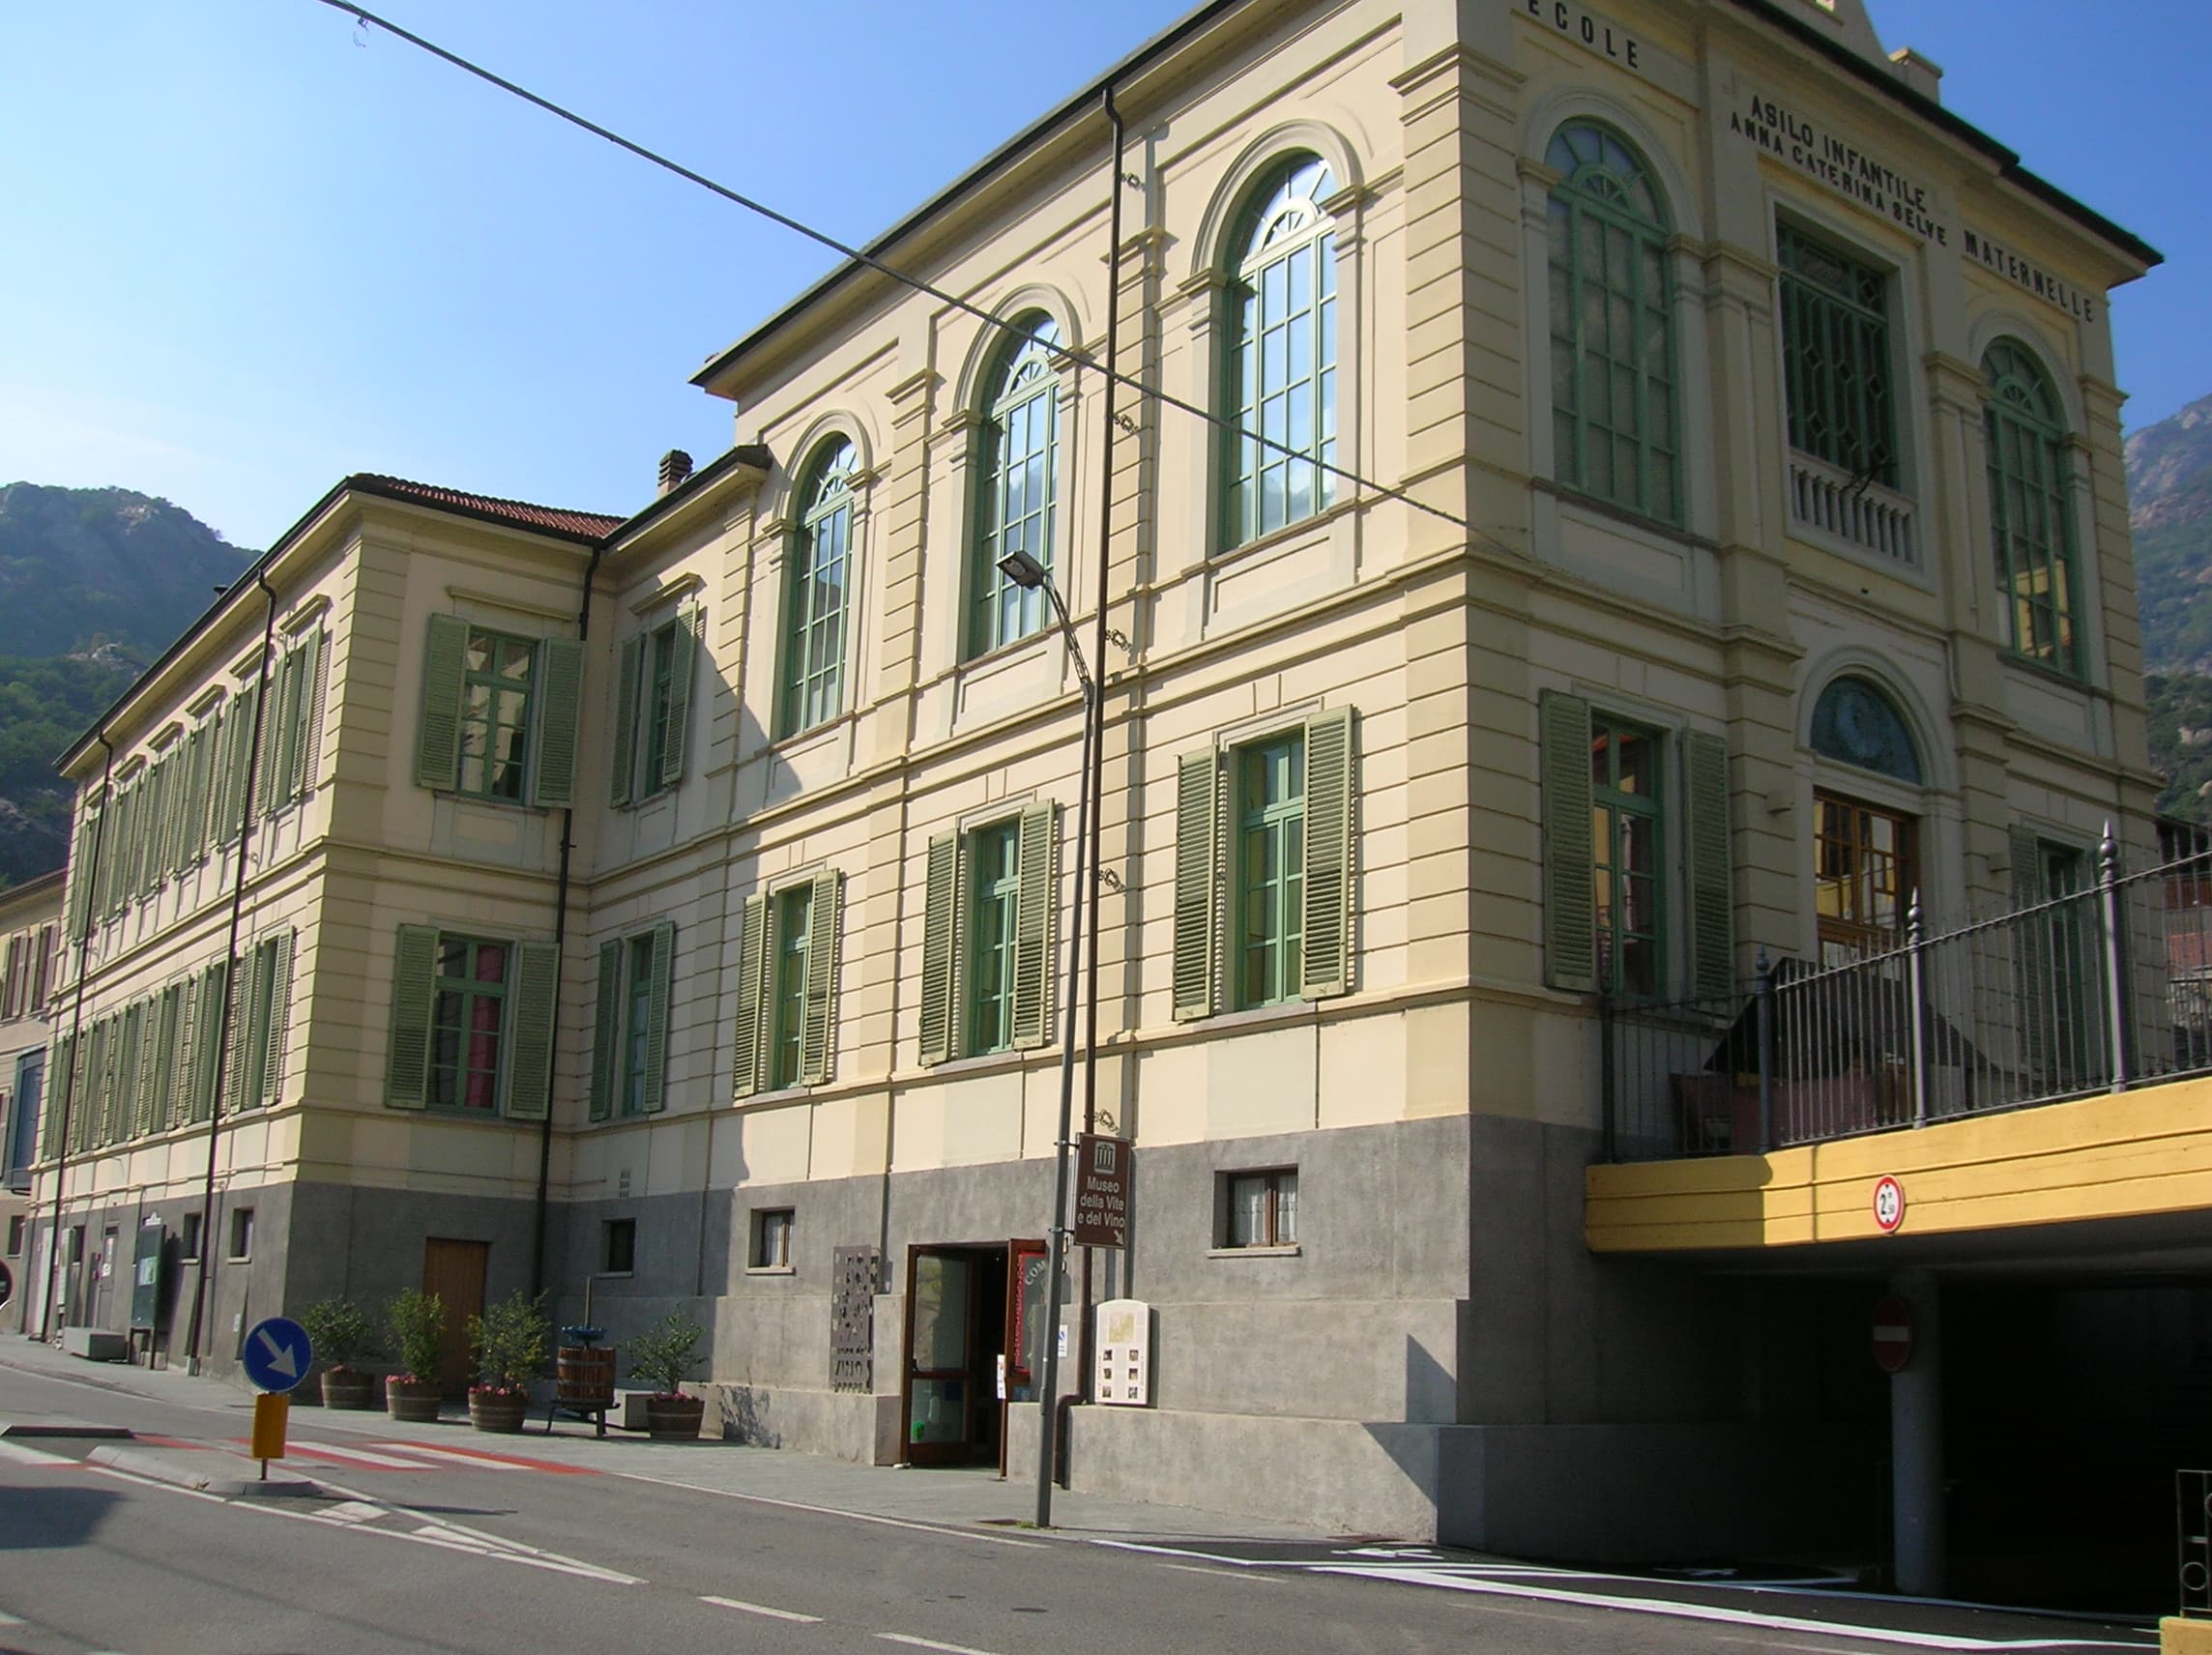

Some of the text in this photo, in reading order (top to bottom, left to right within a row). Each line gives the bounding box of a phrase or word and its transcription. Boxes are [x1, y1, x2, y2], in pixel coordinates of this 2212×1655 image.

[1752, 95, 1927, 214] ASILO INFANTILE
[1732, 111, 1946, 246] ANNA CATERINA SELVE
[1964, 229, 2093, 322] MATERNELLE
[1087, 1176, 1120, 1192] Museo
[1080, 1193, 1124, 1210] della Vite
[1077, 1211, 1125, 1228] e del Vino
[1025, 1260, 1047, 1286] COM
